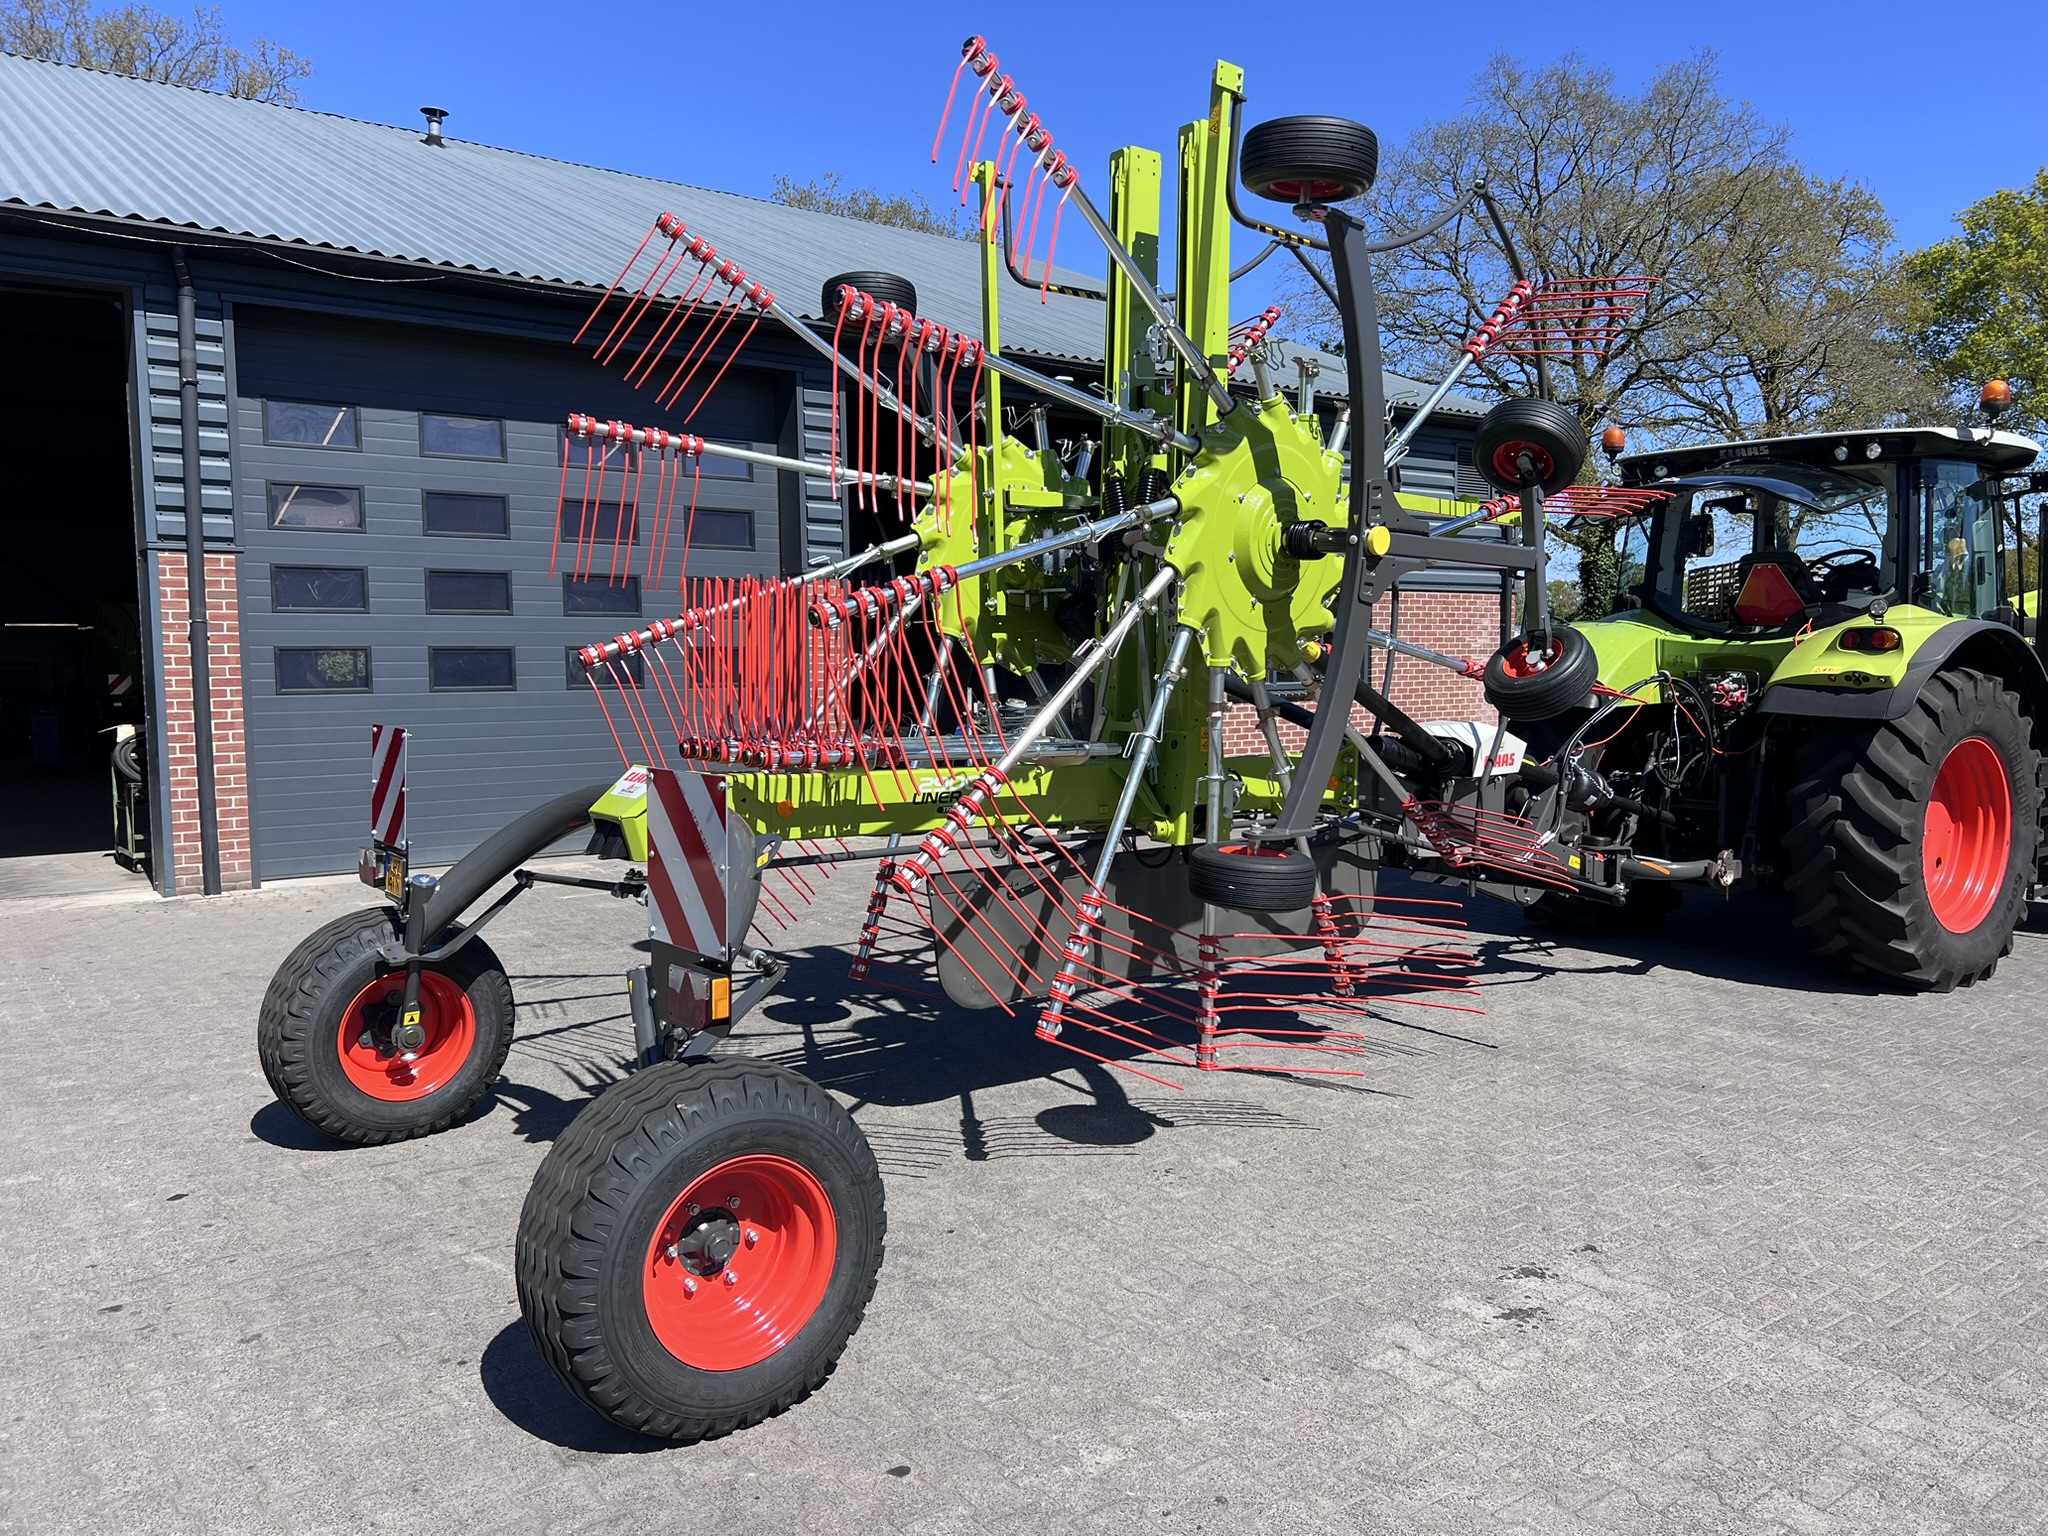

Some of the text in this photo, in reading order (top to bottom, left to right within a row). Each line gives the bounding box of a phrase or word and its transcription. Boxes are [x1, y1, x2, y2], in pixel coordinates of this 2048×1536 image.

[1719, 445, 1769, 458] CLAAS
[1483, 752, 1516, 769] AAS
[623, 771, 647, 784] CLAA
[912, 790, 962, 805] LINER
